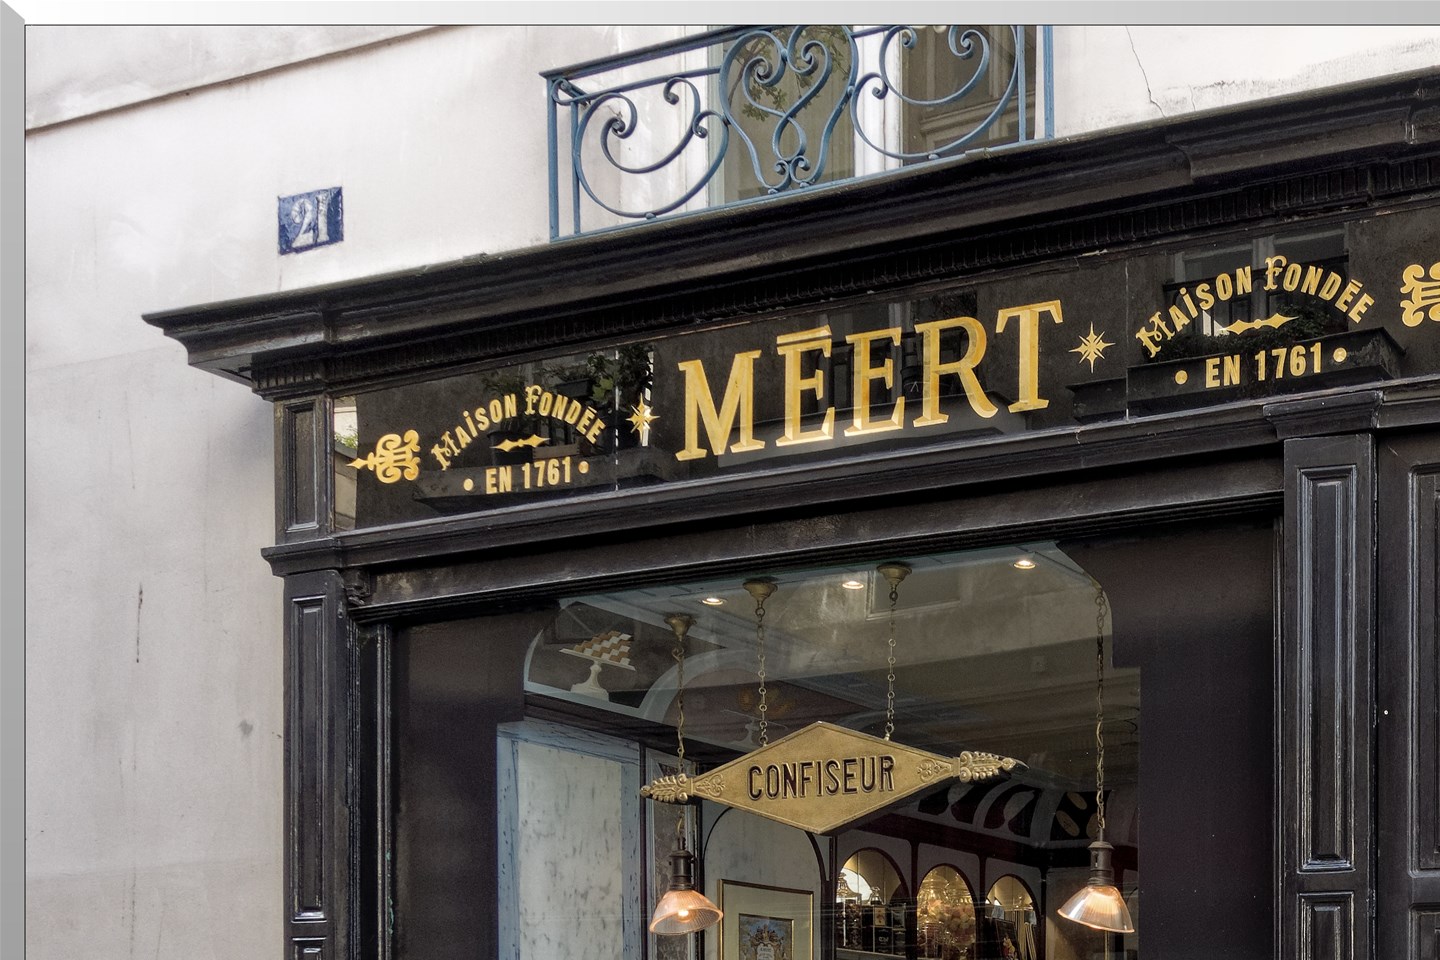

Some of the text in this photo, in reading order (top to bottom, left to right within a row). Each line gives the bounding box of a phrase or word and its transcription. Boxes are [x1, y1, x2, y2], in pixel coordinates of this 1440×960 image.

[291, 193, 330, 248] 21
[1205, 342, 1322, 389] EN 1761
[486, 456, 572, 495] EN 1761
[748, 754, 896, 801] CONFISEUR
